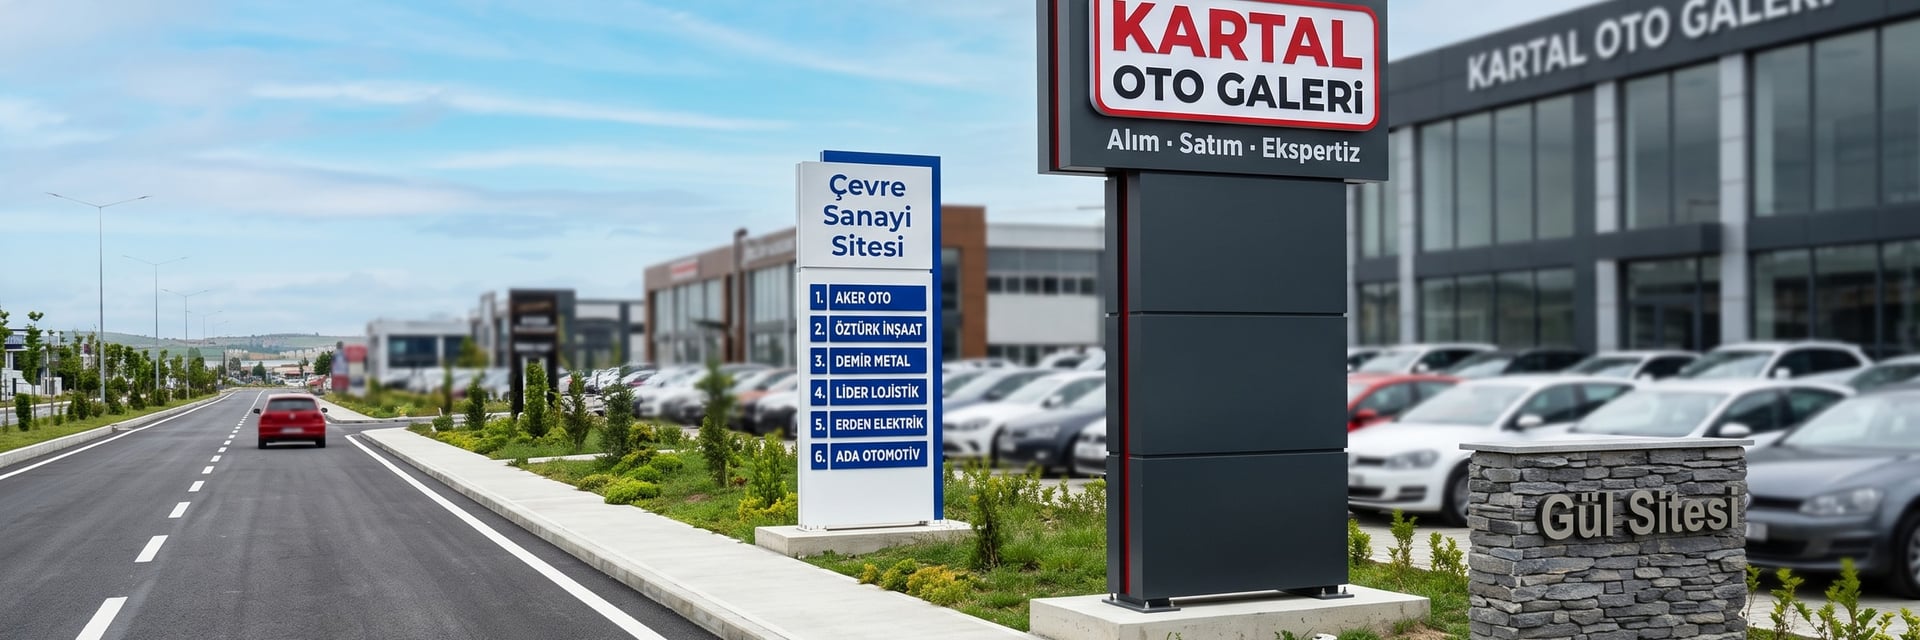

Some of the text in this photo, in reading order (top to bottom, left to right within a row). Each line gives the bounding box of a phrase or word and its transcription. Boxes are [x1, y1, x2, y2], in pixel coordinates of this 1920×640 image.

[1113, 0, 1362, 70] KARTAL
[1468, 0, 1834, 91] KARTAL OTO GAL
[1113, 65, 1204, 103] OTO
[1107, 129, 1159, 151] Alım
[1180, 133, 1242, 156] Satım
[1263, 137, 1360, 163] Ekspertiz
[830, 174, 905, 201] Çevre
[824, 205, 910, 232] Sanayi
[832, 234, 903, 257] Sitesi
[816, 291, 891, 304] 1. AKER OTO
[815, 320, 922, 338] 2. ÖZTÜRK İNŞAAT
[815, 353, 910, 367] 3. DEMİR METAL
[815, 384, 919, 398] 4. LİDER LOJİSTİK
[816, 415, 923, 430] 5. ERDEN ELEKTRİK
[816, 446, 920, 462] 6. ADA OTOMOTİV
[1541, 487, 1739, 541] Gül Sitesi
